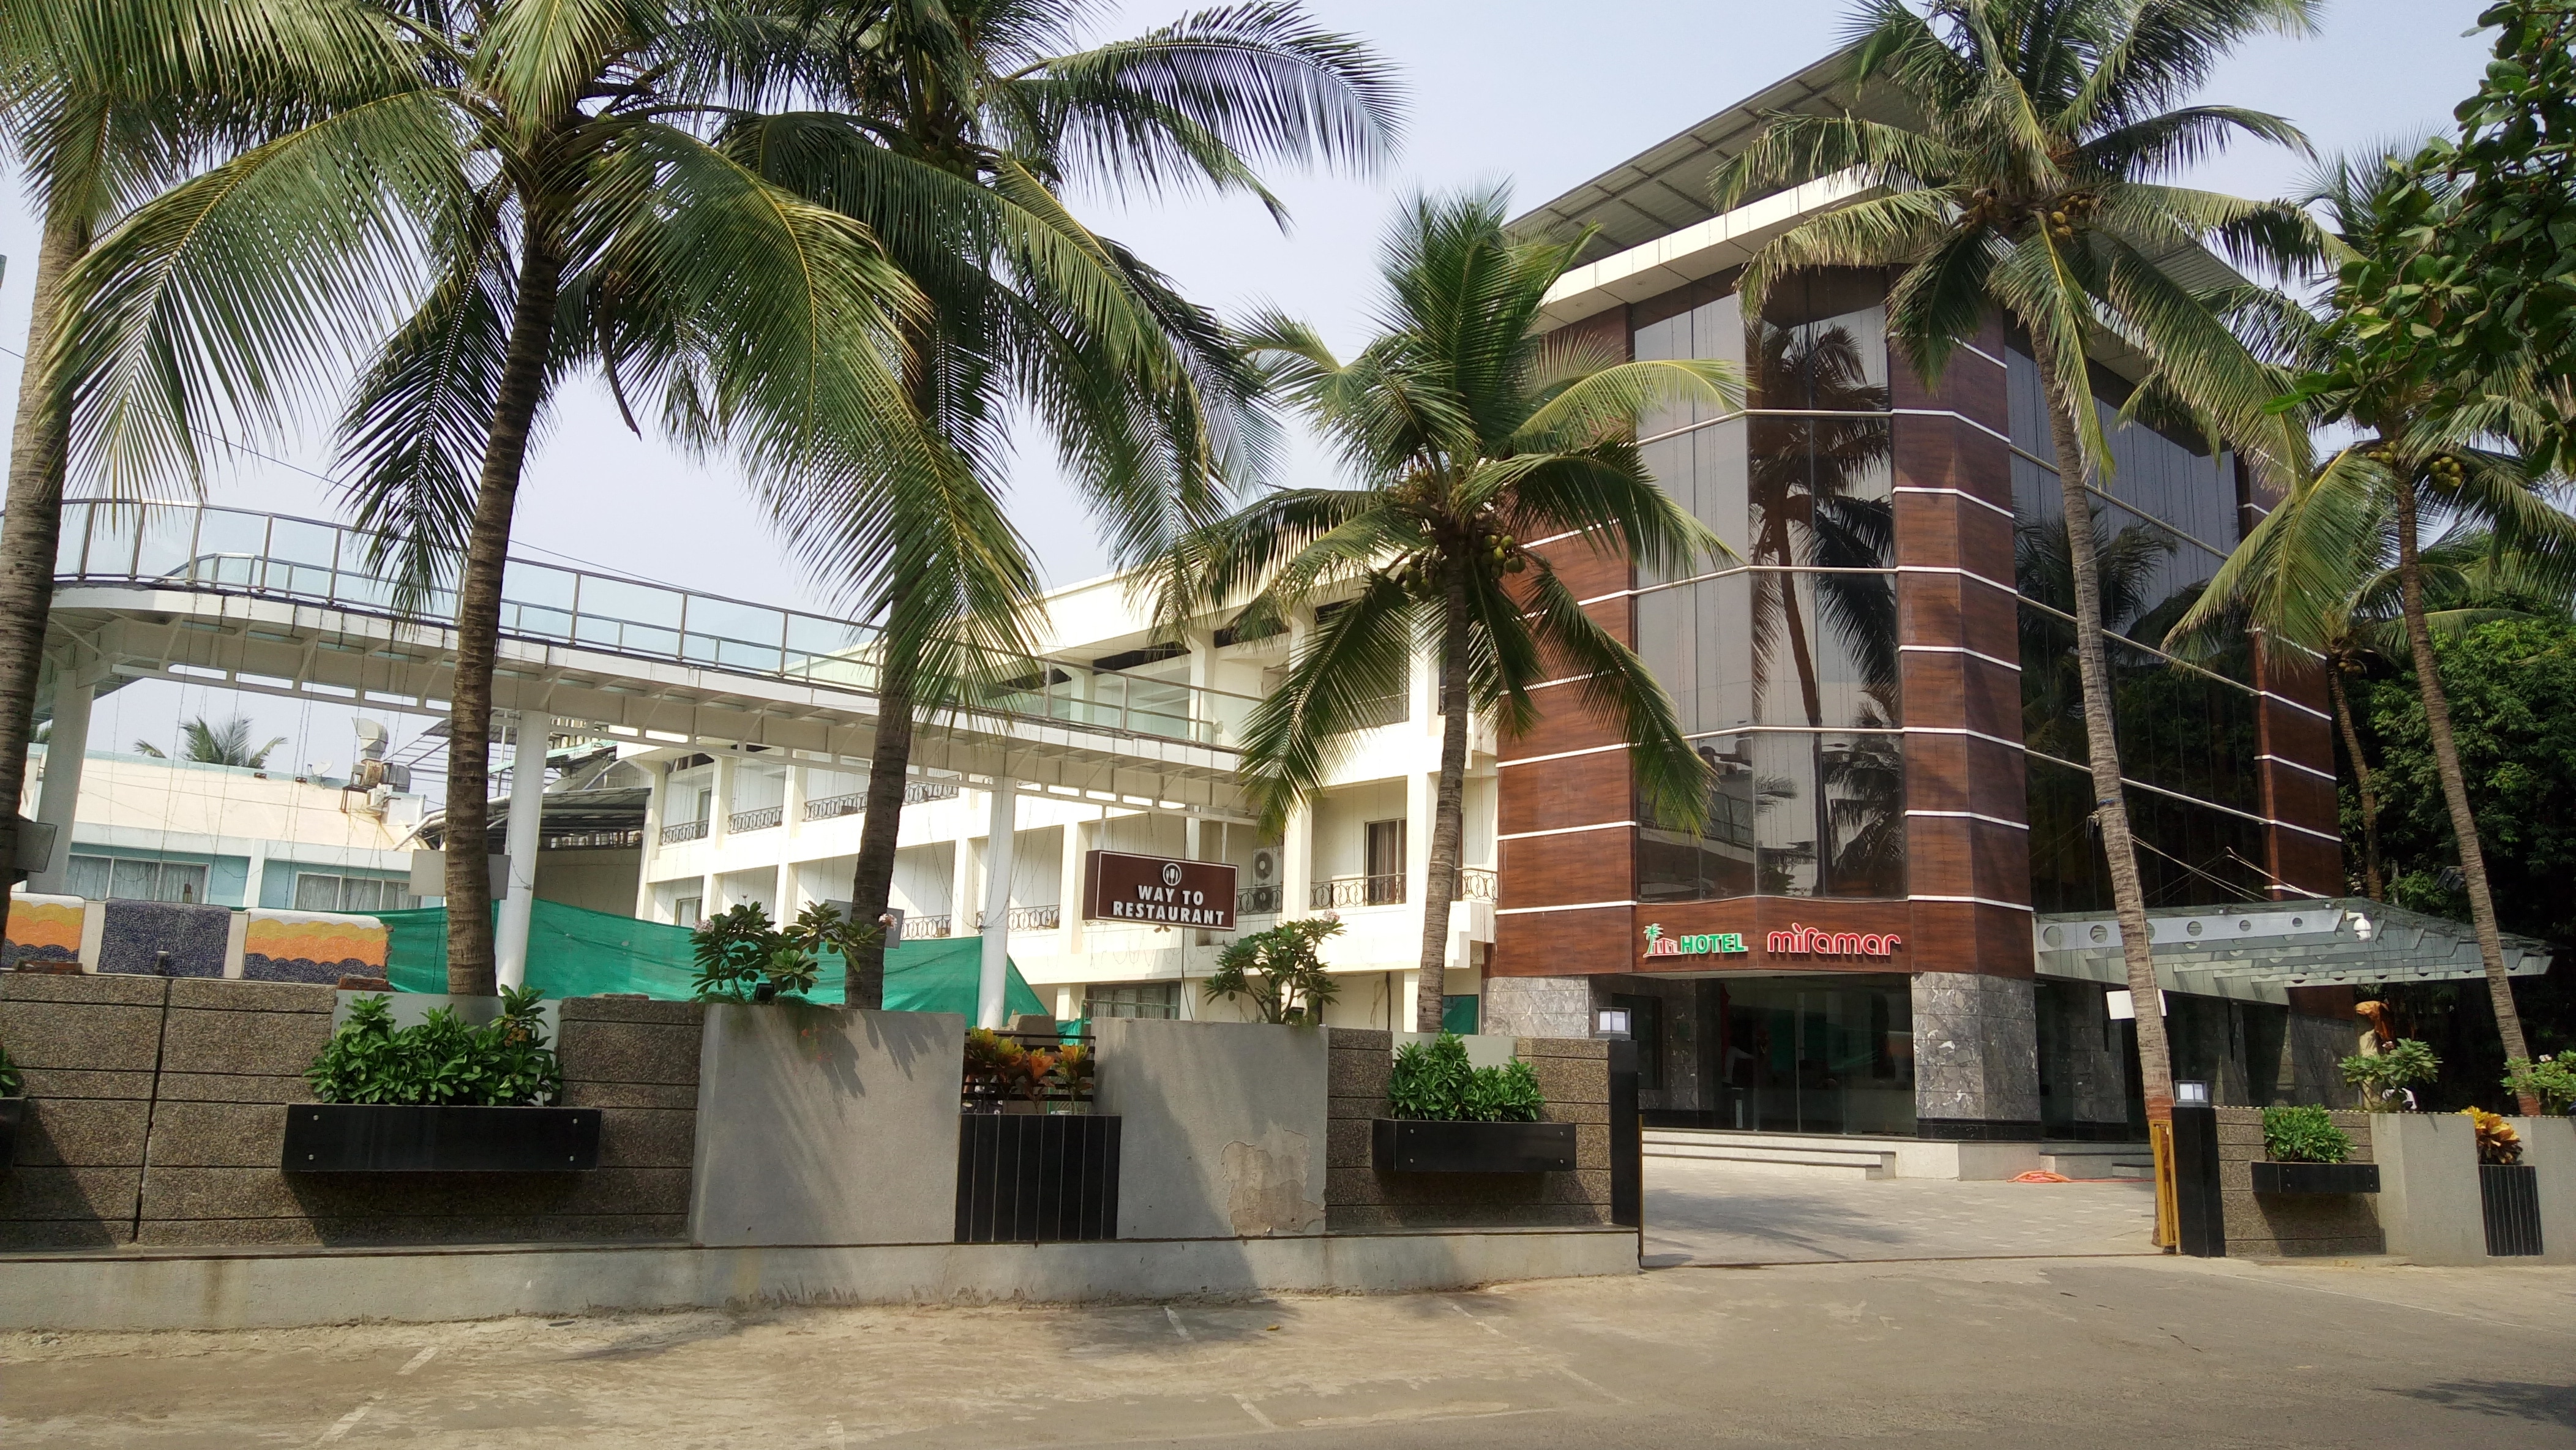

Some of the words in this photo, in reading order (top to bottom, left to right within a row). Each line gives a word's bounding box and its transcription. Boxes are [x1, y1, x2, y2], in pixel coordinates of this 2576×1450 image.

[1137, 885, 1175, 903] WAY
[1182, 890, 1204, 906] TO
[1112, 901, 1224, 925] RESTAURANT
[1680, 933, 1749, 954] HOTEL
[1767, 922, 1901, 956] miramar
